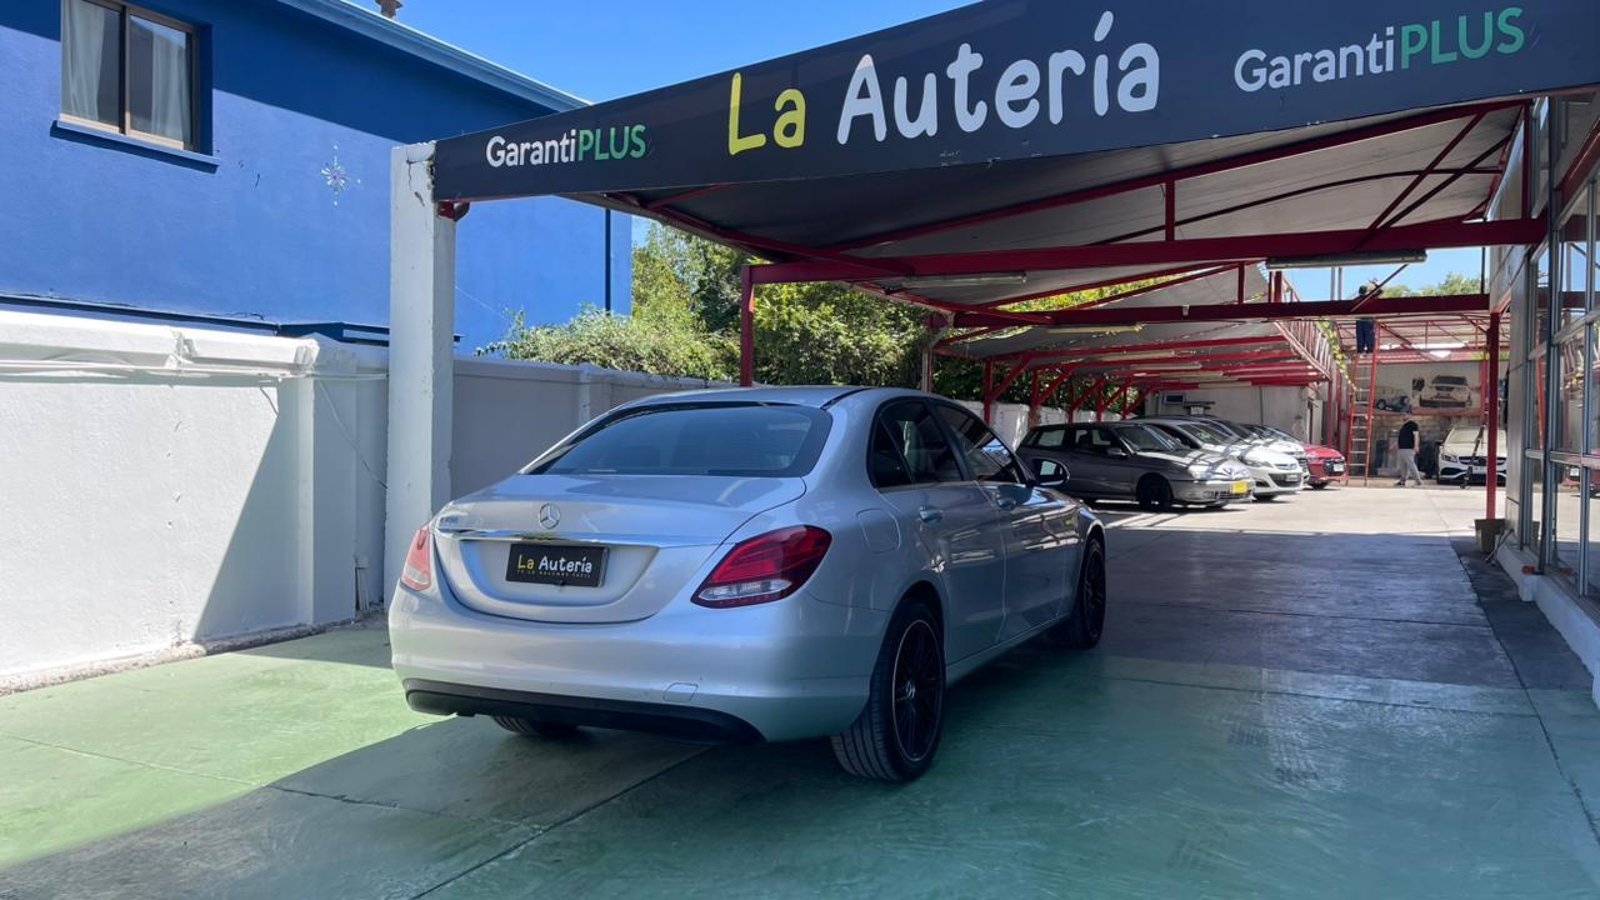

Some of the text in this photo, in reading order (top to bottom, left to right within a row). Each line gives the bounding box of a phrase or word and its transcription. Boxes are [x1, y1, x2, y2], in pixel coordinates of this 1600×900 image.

[1233, 7, 1526, 93] GarantiPLUS
[728, 10, 1160, 156] La Autería
[485, 123, 647, 168] GarantiPLUS
[517, 554, 593, 574] La Autería
